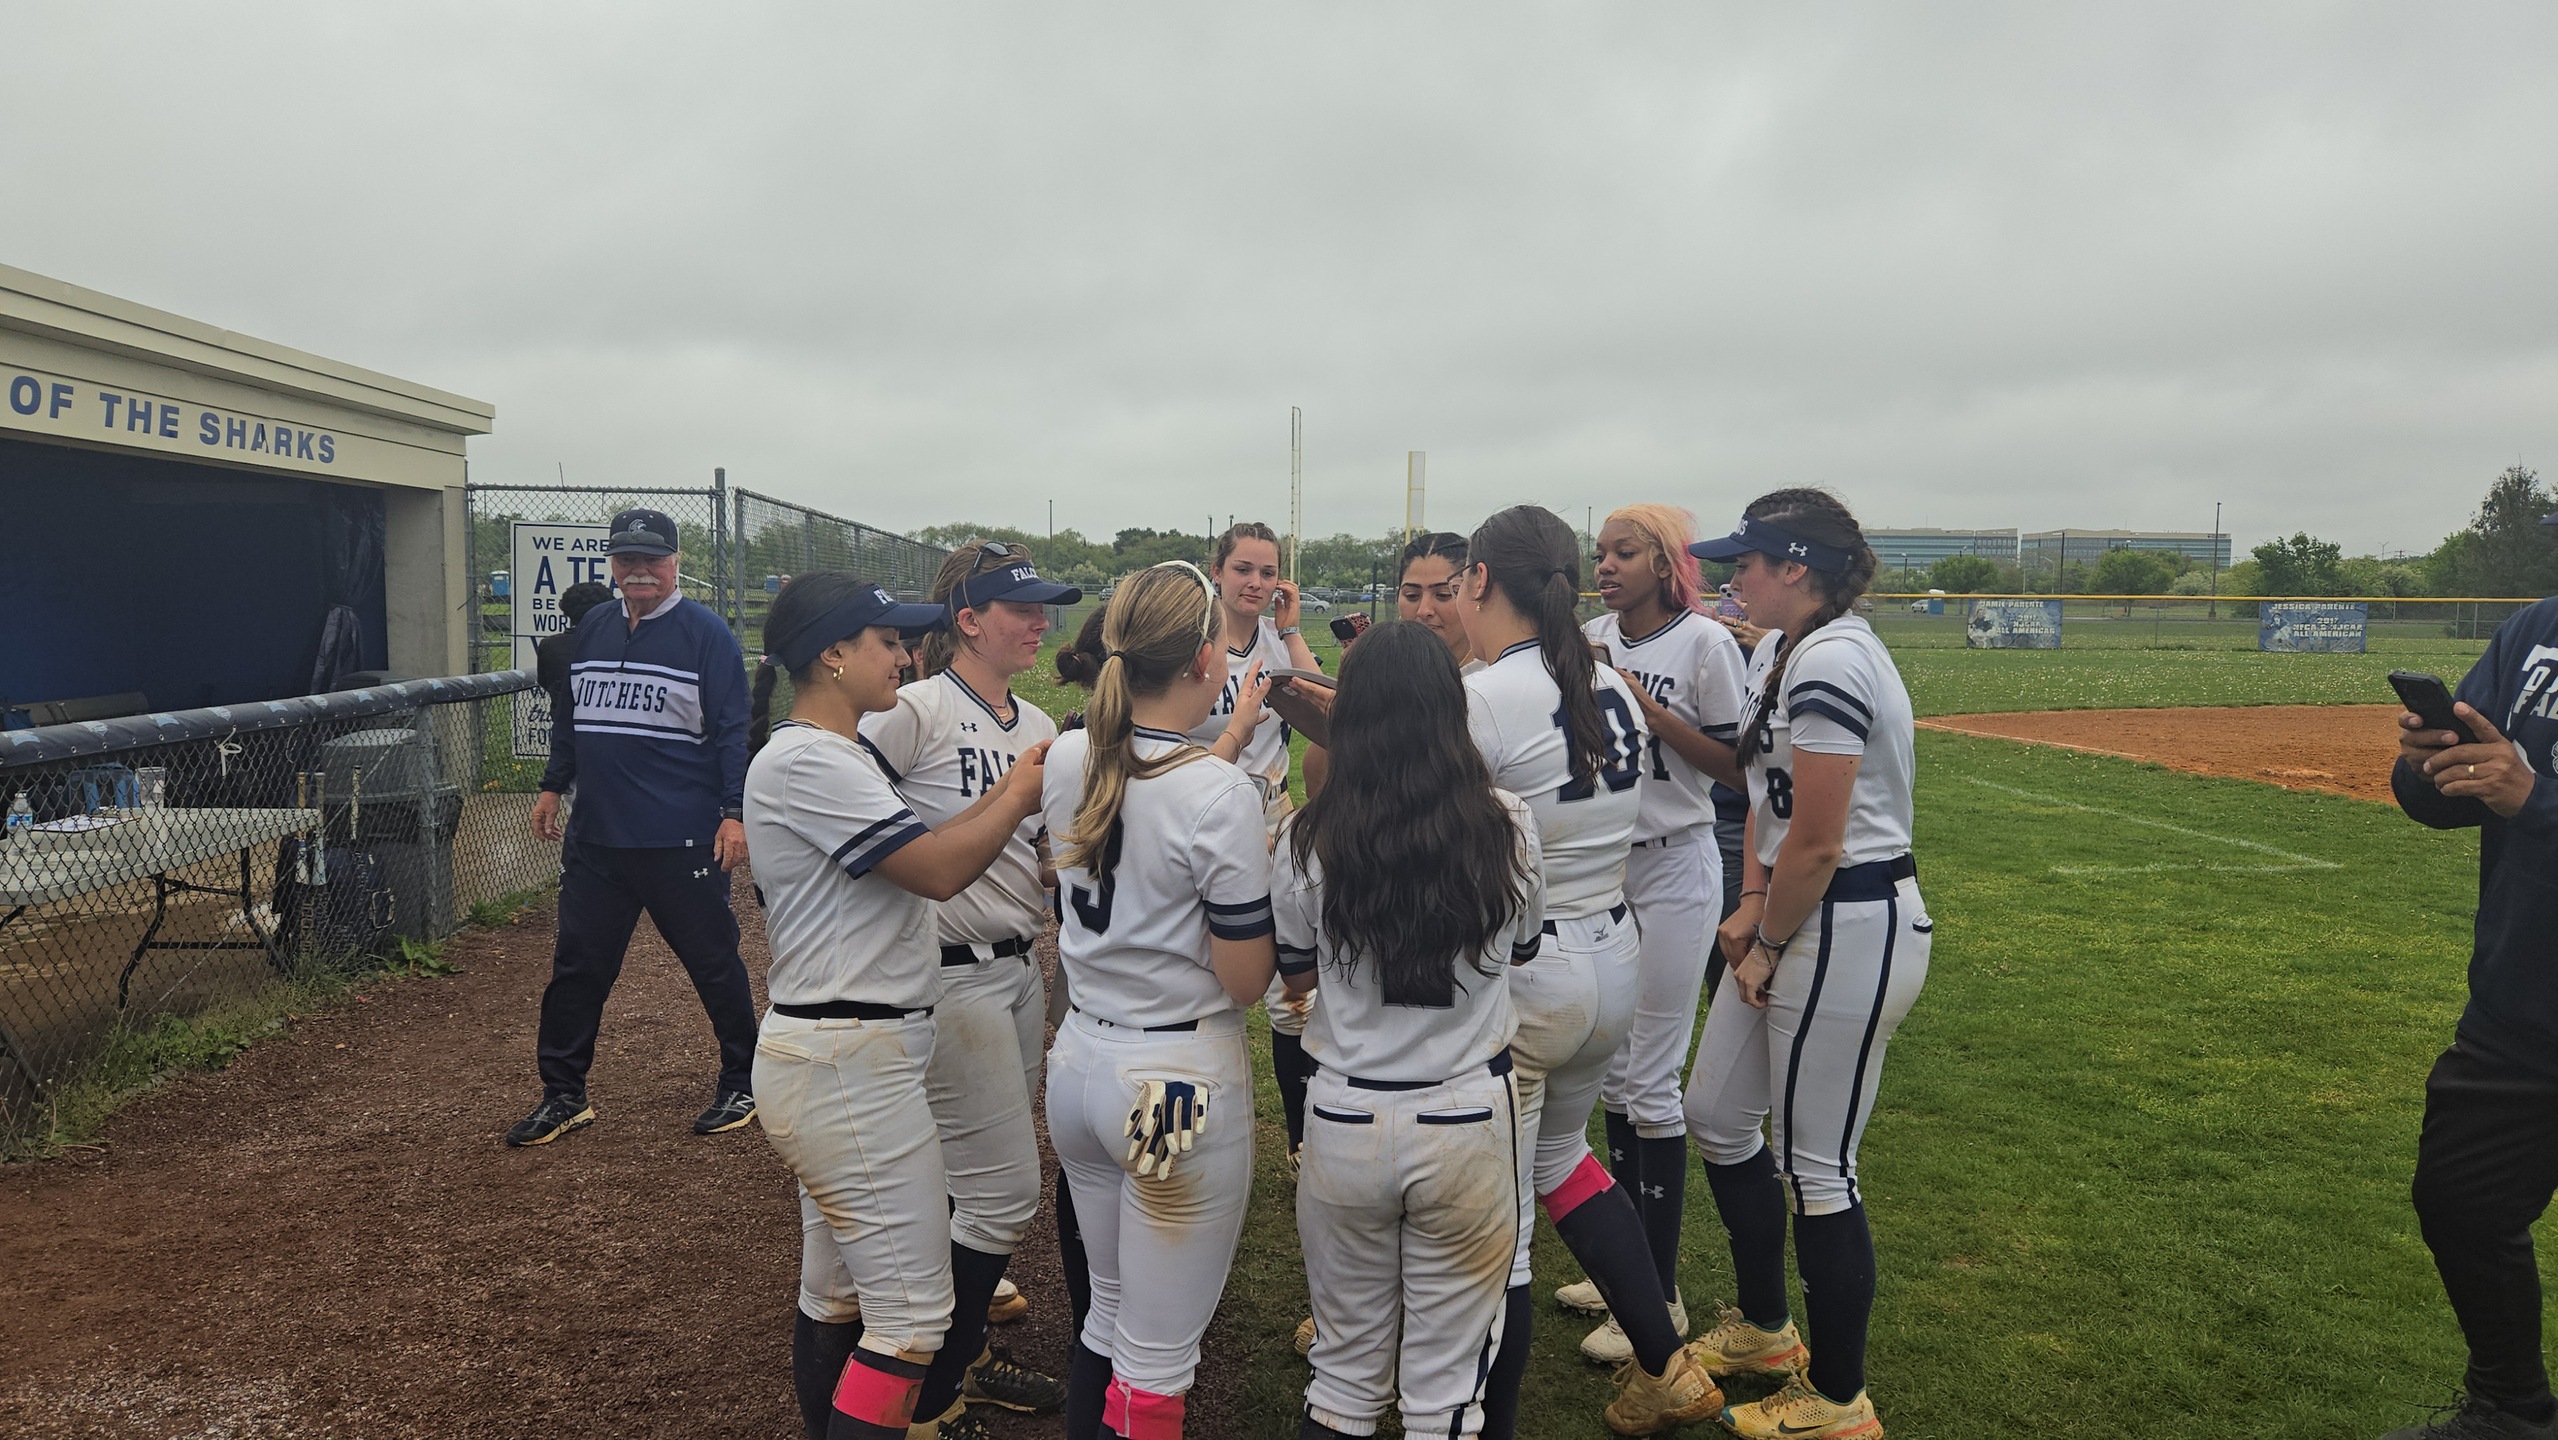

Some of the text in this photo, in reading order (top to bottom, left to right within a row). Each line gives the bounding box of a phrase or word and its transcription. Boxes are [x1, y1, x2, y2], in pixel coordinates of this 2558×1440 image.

[10, 376, 335, 464] OF THE SHARKS
[532, 537, 610, 552] WE ARE
[534, 556, 557, 594] A
[533, 599, 556, 610] BE
[1550, 685, 1642, 804] 10
